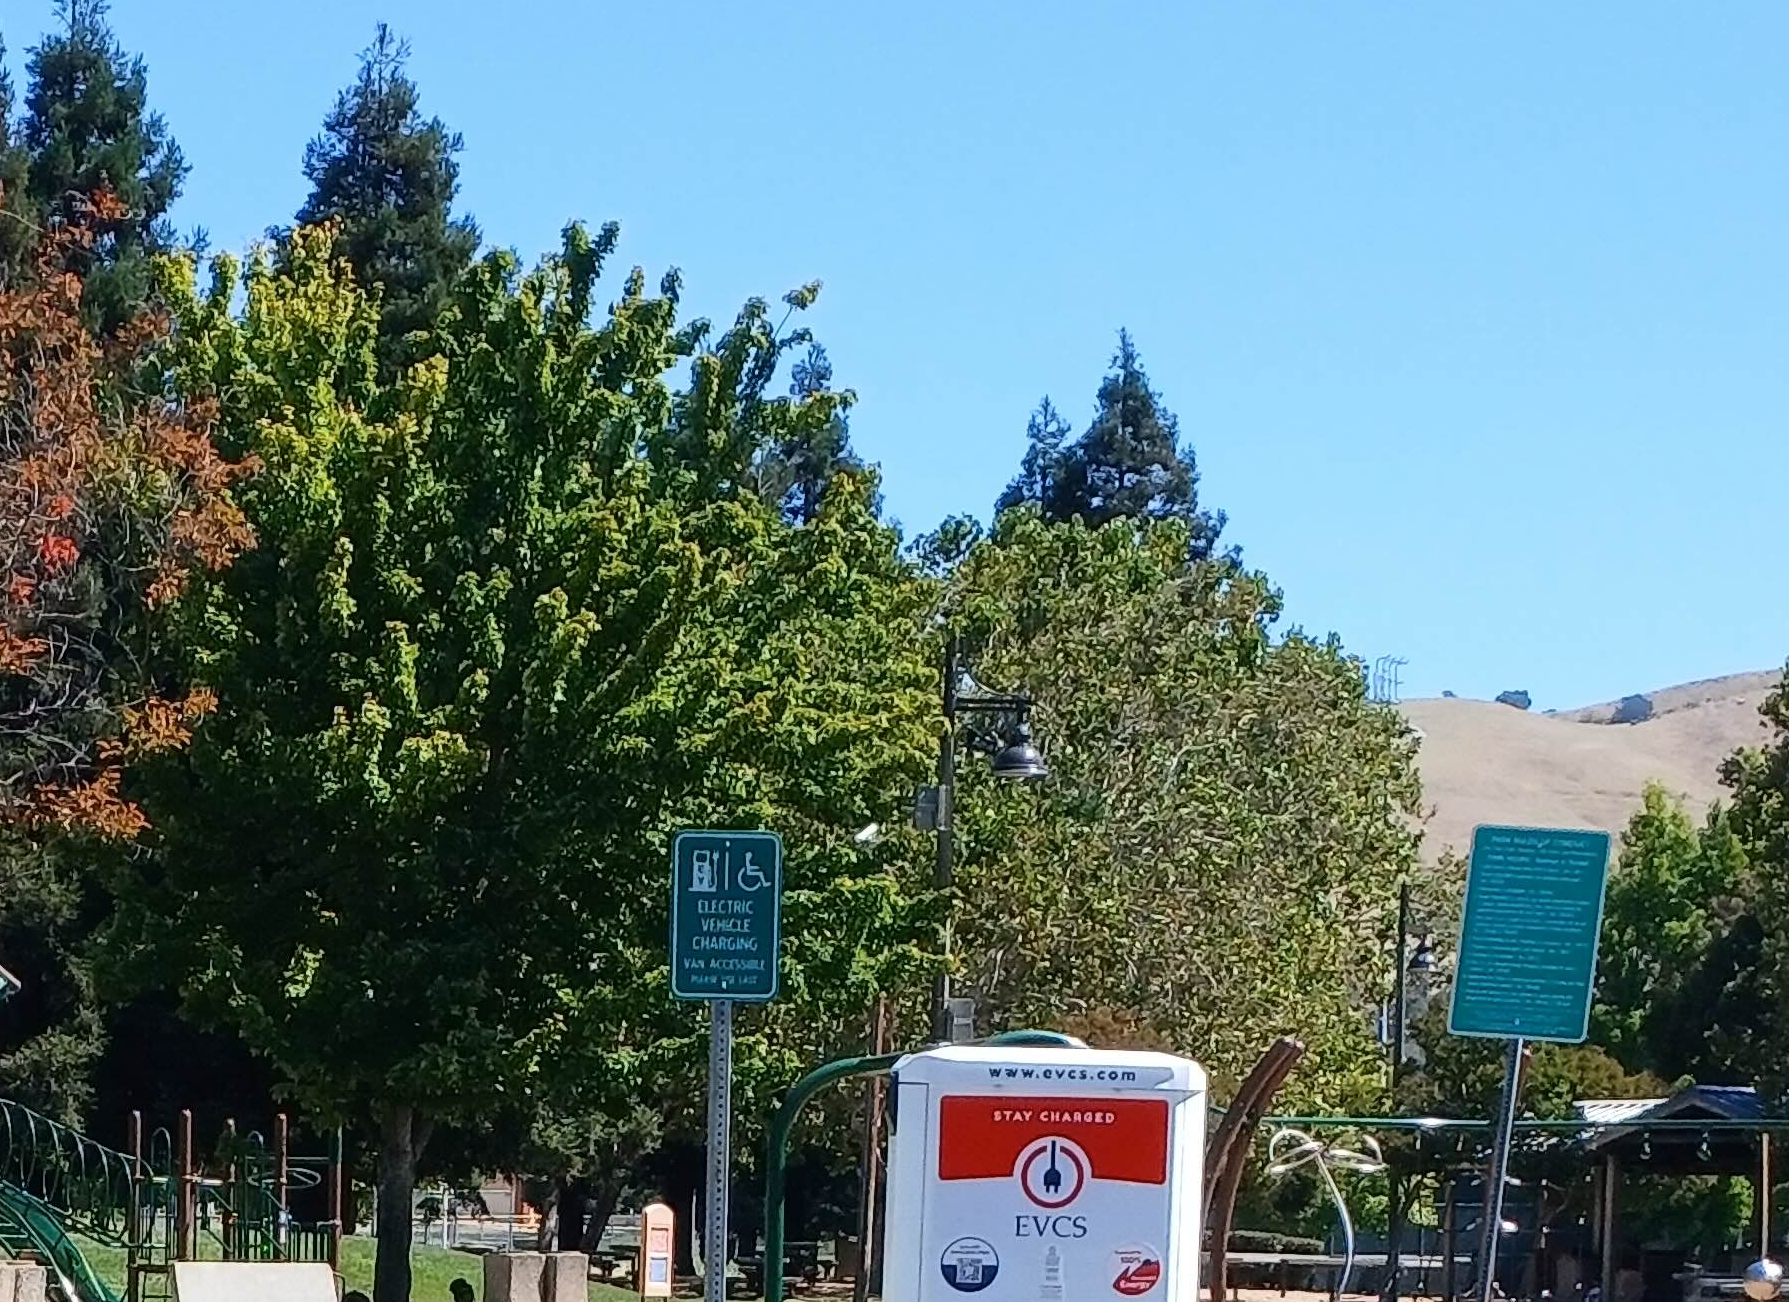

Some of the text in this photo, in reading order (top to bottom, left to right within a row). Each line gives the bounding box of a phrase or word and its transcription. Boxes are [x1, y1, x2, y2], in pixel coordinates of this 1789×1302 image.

[698, 899, 754, 914] ELECTRIC
[701, 917, 751, 933] VEHICLE
[692, 936, 758, 951] CHARGING
[683, 957, 765, 970] VAN ACCESSIBLE
[989, 1068, 1136, 1082] www.evcs.com
[993, 1110, 1115, 1123] STAY CHARGED
[1015, 1216, 1088, 1238] EVCS
